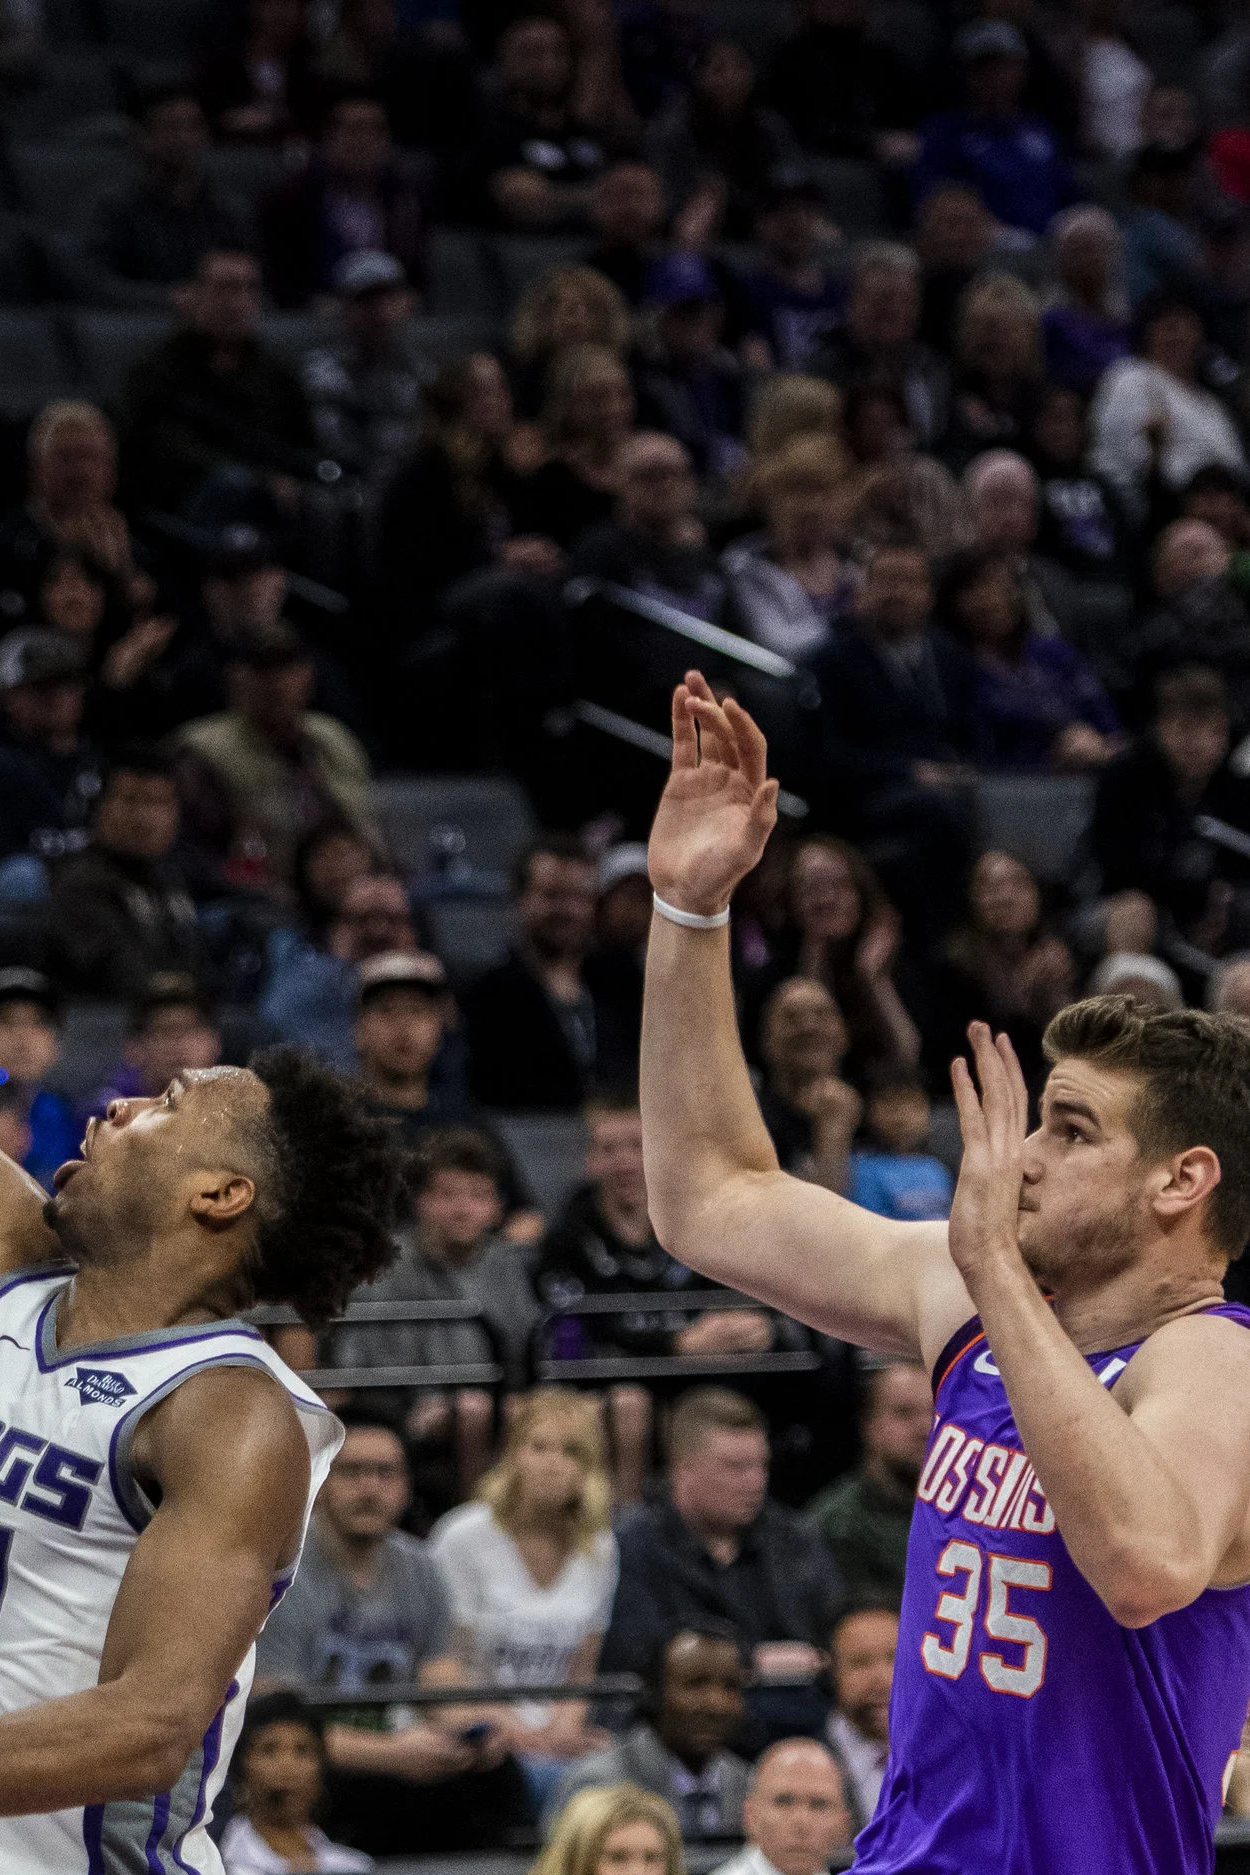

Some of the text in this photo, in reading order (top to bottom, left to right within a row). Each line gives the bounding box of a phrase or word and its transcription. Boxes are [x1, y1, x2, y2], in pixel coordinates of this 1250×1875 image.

[68, 1379, 123, 1407] ALMONDS
[917, 1413, 986, 1515] OS
[921, 1538, 1053, 1699] 35
